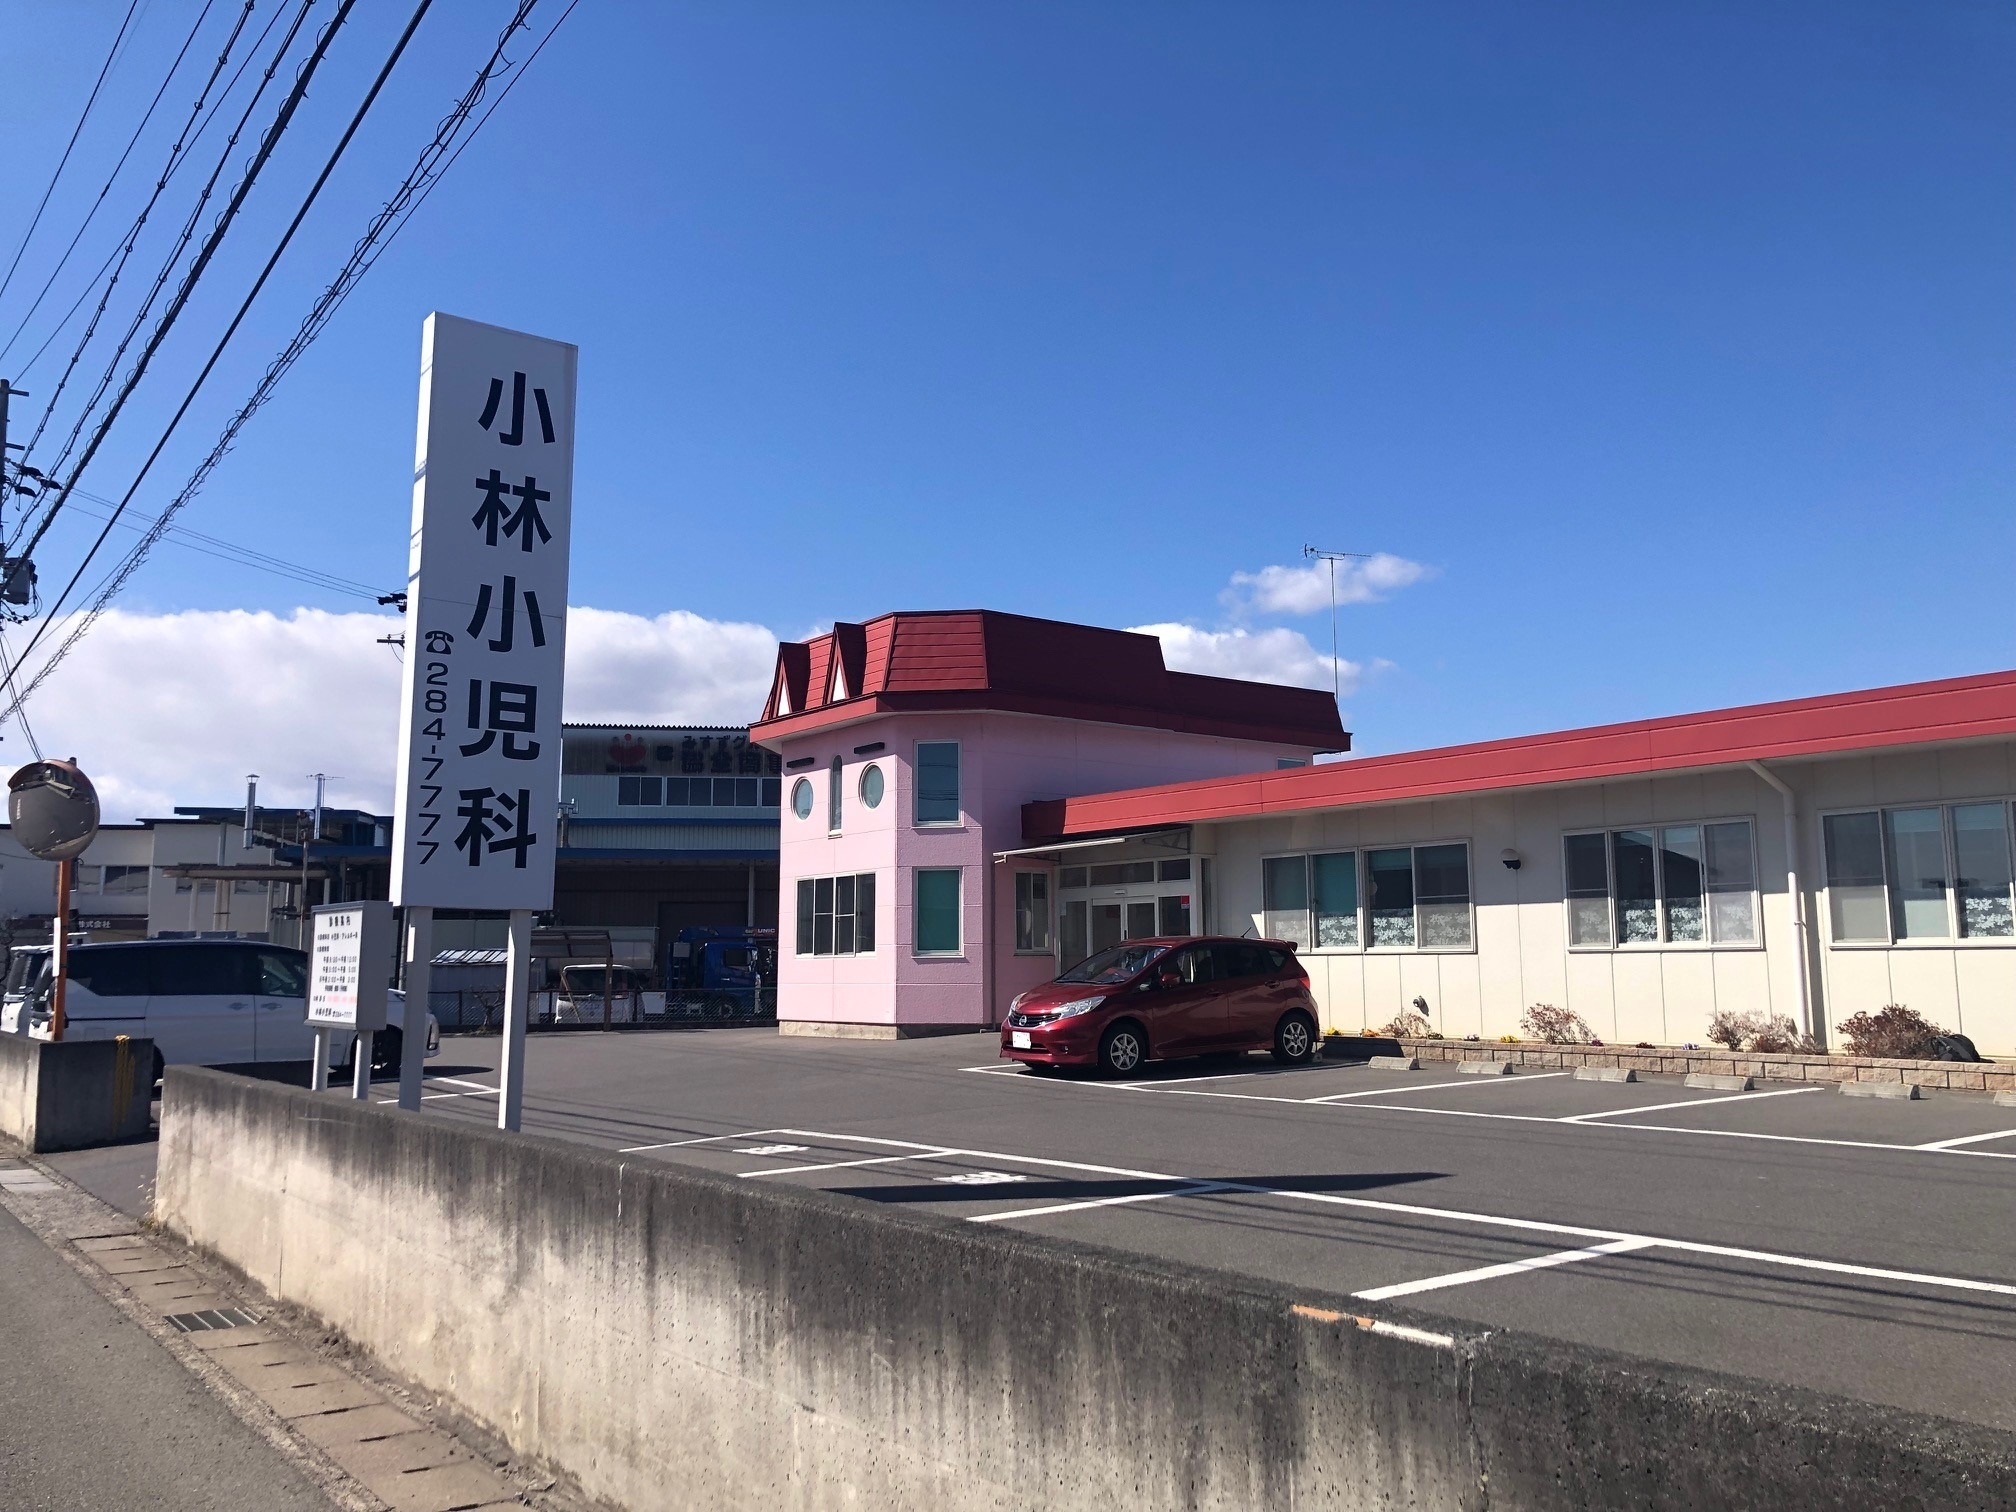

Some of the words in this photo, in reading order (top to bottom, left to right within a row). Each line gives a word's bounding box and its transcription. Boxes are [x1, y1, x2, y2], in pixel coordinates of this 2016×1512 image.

[416, 662, 449, 865] 284-7777
[454, 371, 556, 869] 小林小児科
